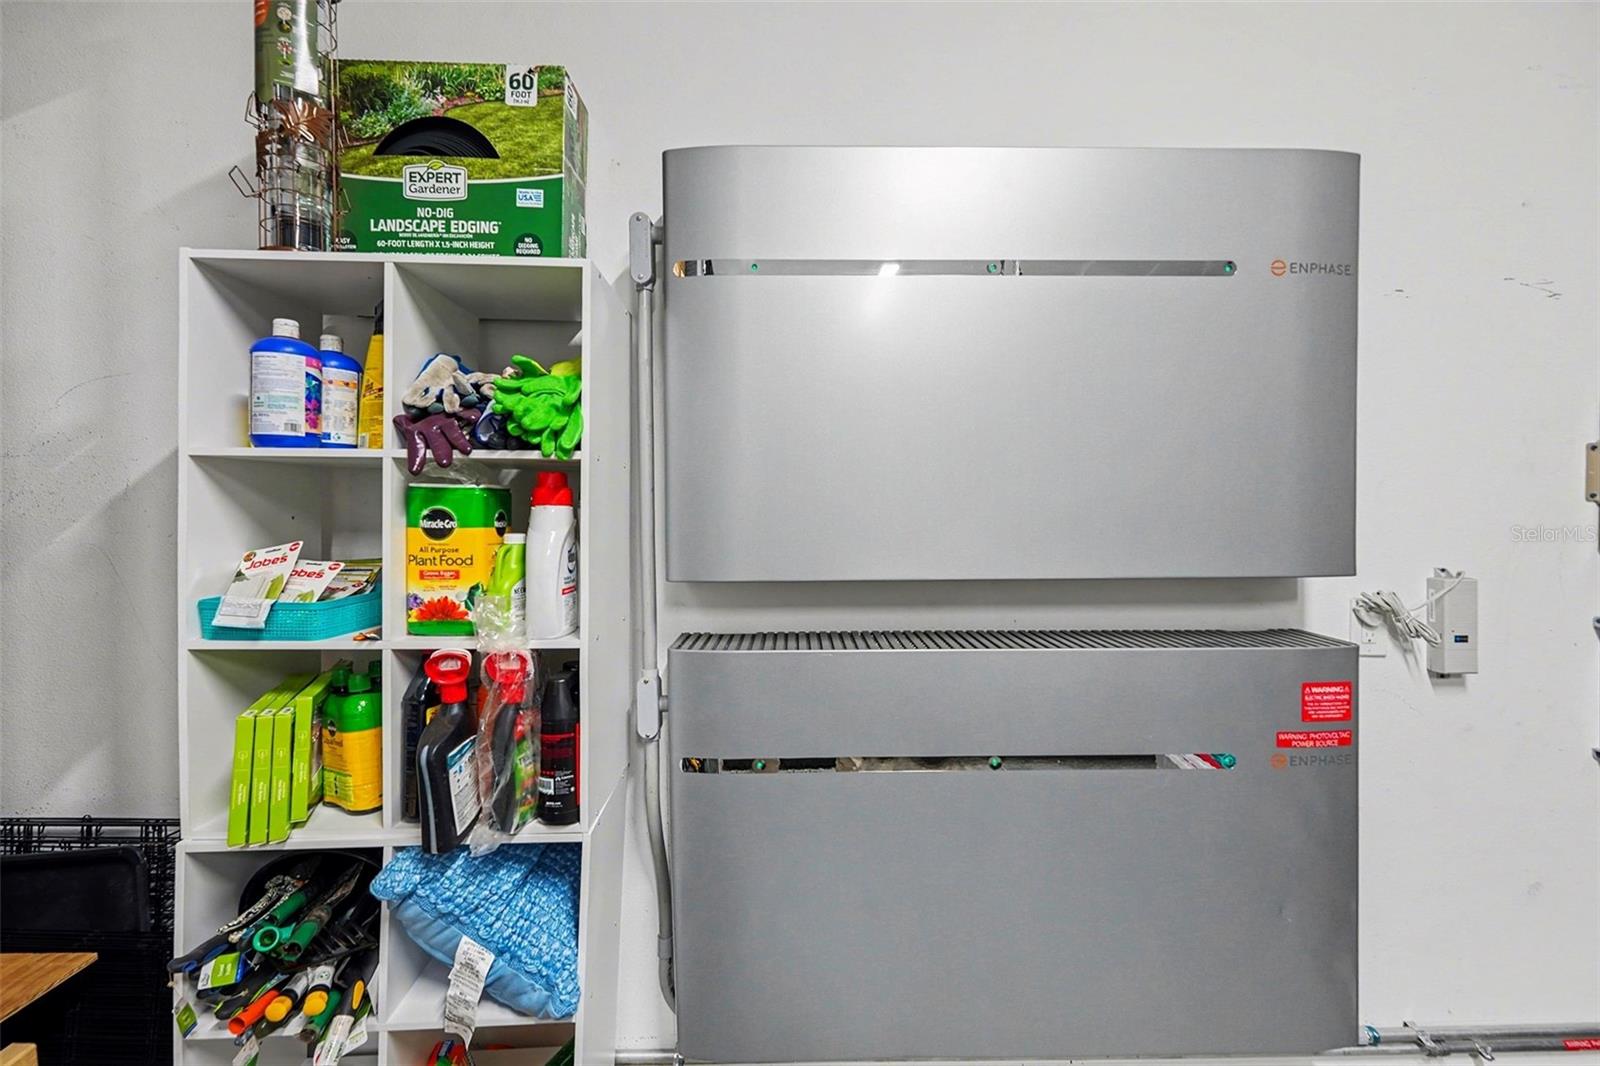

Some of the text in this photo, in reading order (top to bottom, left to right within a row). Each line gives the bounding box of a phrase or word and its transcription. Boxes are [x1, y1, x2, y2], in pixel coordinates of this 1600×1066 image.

[509, 73, 534, 90] 60
[409, 171, 462, 184] EXPERT
[409, 183, 461, 195] Gardener
[416, 207, 454, 218] NO-DIG
[370, 219, 446, 232] LANDSCAPE
[469, 241, 495, 249] HEIGHT
[1289, 262, 1352, 276] ENPHASE
[420, 519, 458, 529] Miracle-Gro
[430, 547, 459, 555] Purpose
[408, 555, 473, 566] Plant Food
[1289, 754, 1352, 767] ENPHASE
